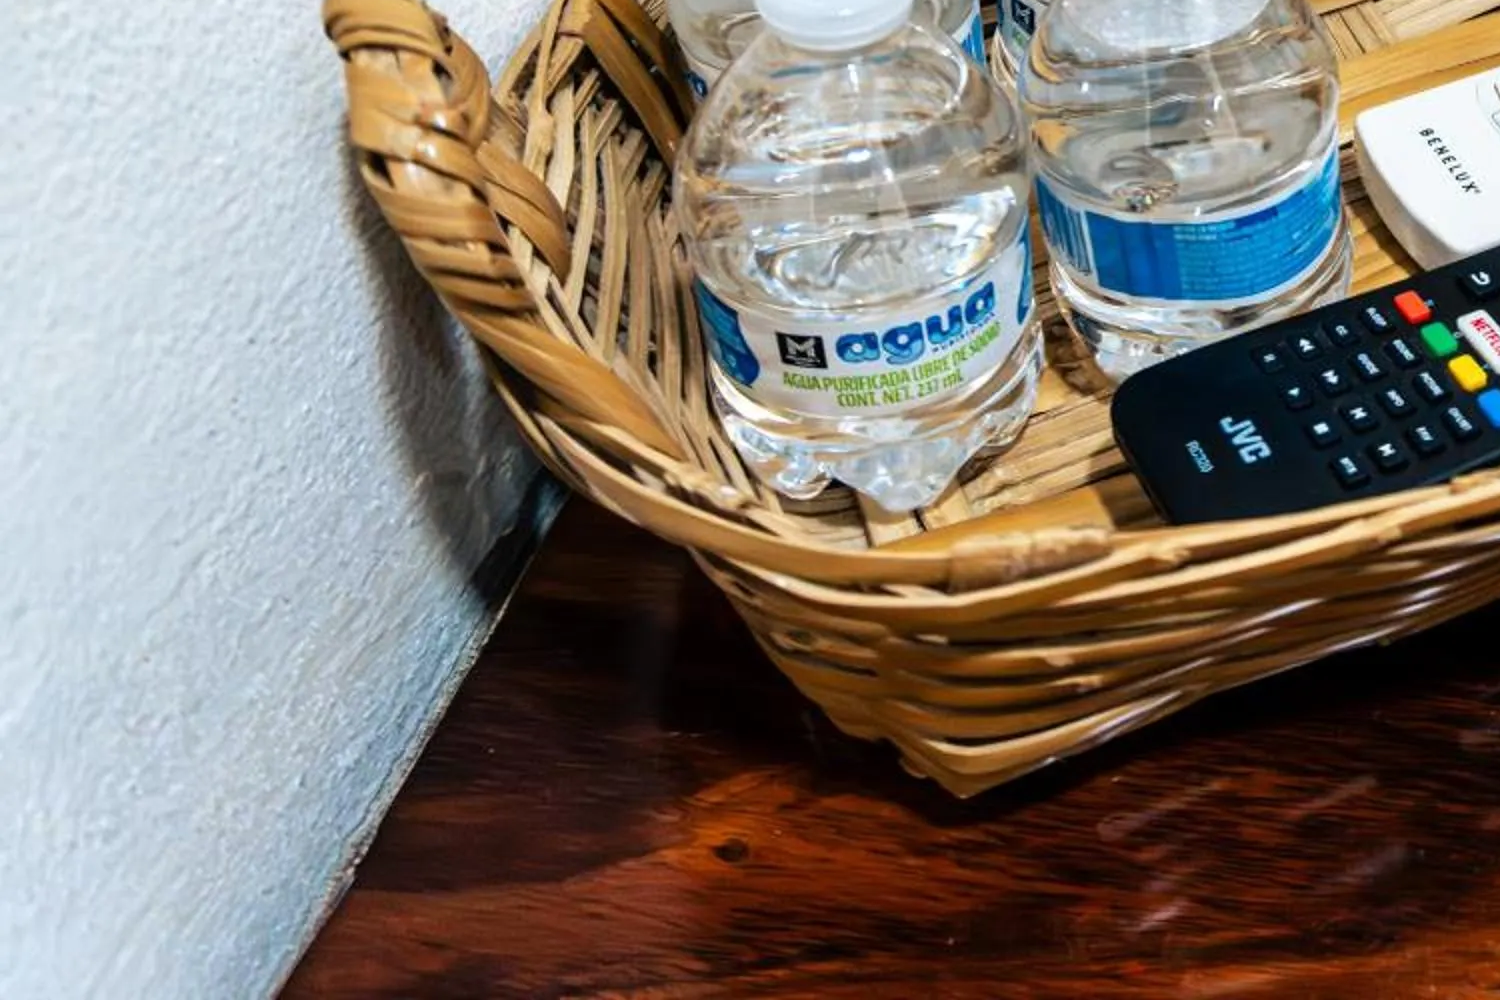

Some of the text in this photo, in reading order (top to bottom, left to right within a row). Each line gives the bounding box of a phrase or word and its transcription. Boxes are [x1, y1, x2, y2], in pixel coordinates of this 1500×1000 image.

[1419, 128, 1479, 193] BENELUX
[835, 281, 996, 366] agua
[782, 371, 822, 391] AGUA
[822, 369, 911, 393] PURIFICADA
[912, 358, 950, 384] LIBRE
[1220, 416, 1272, 464] JVC
